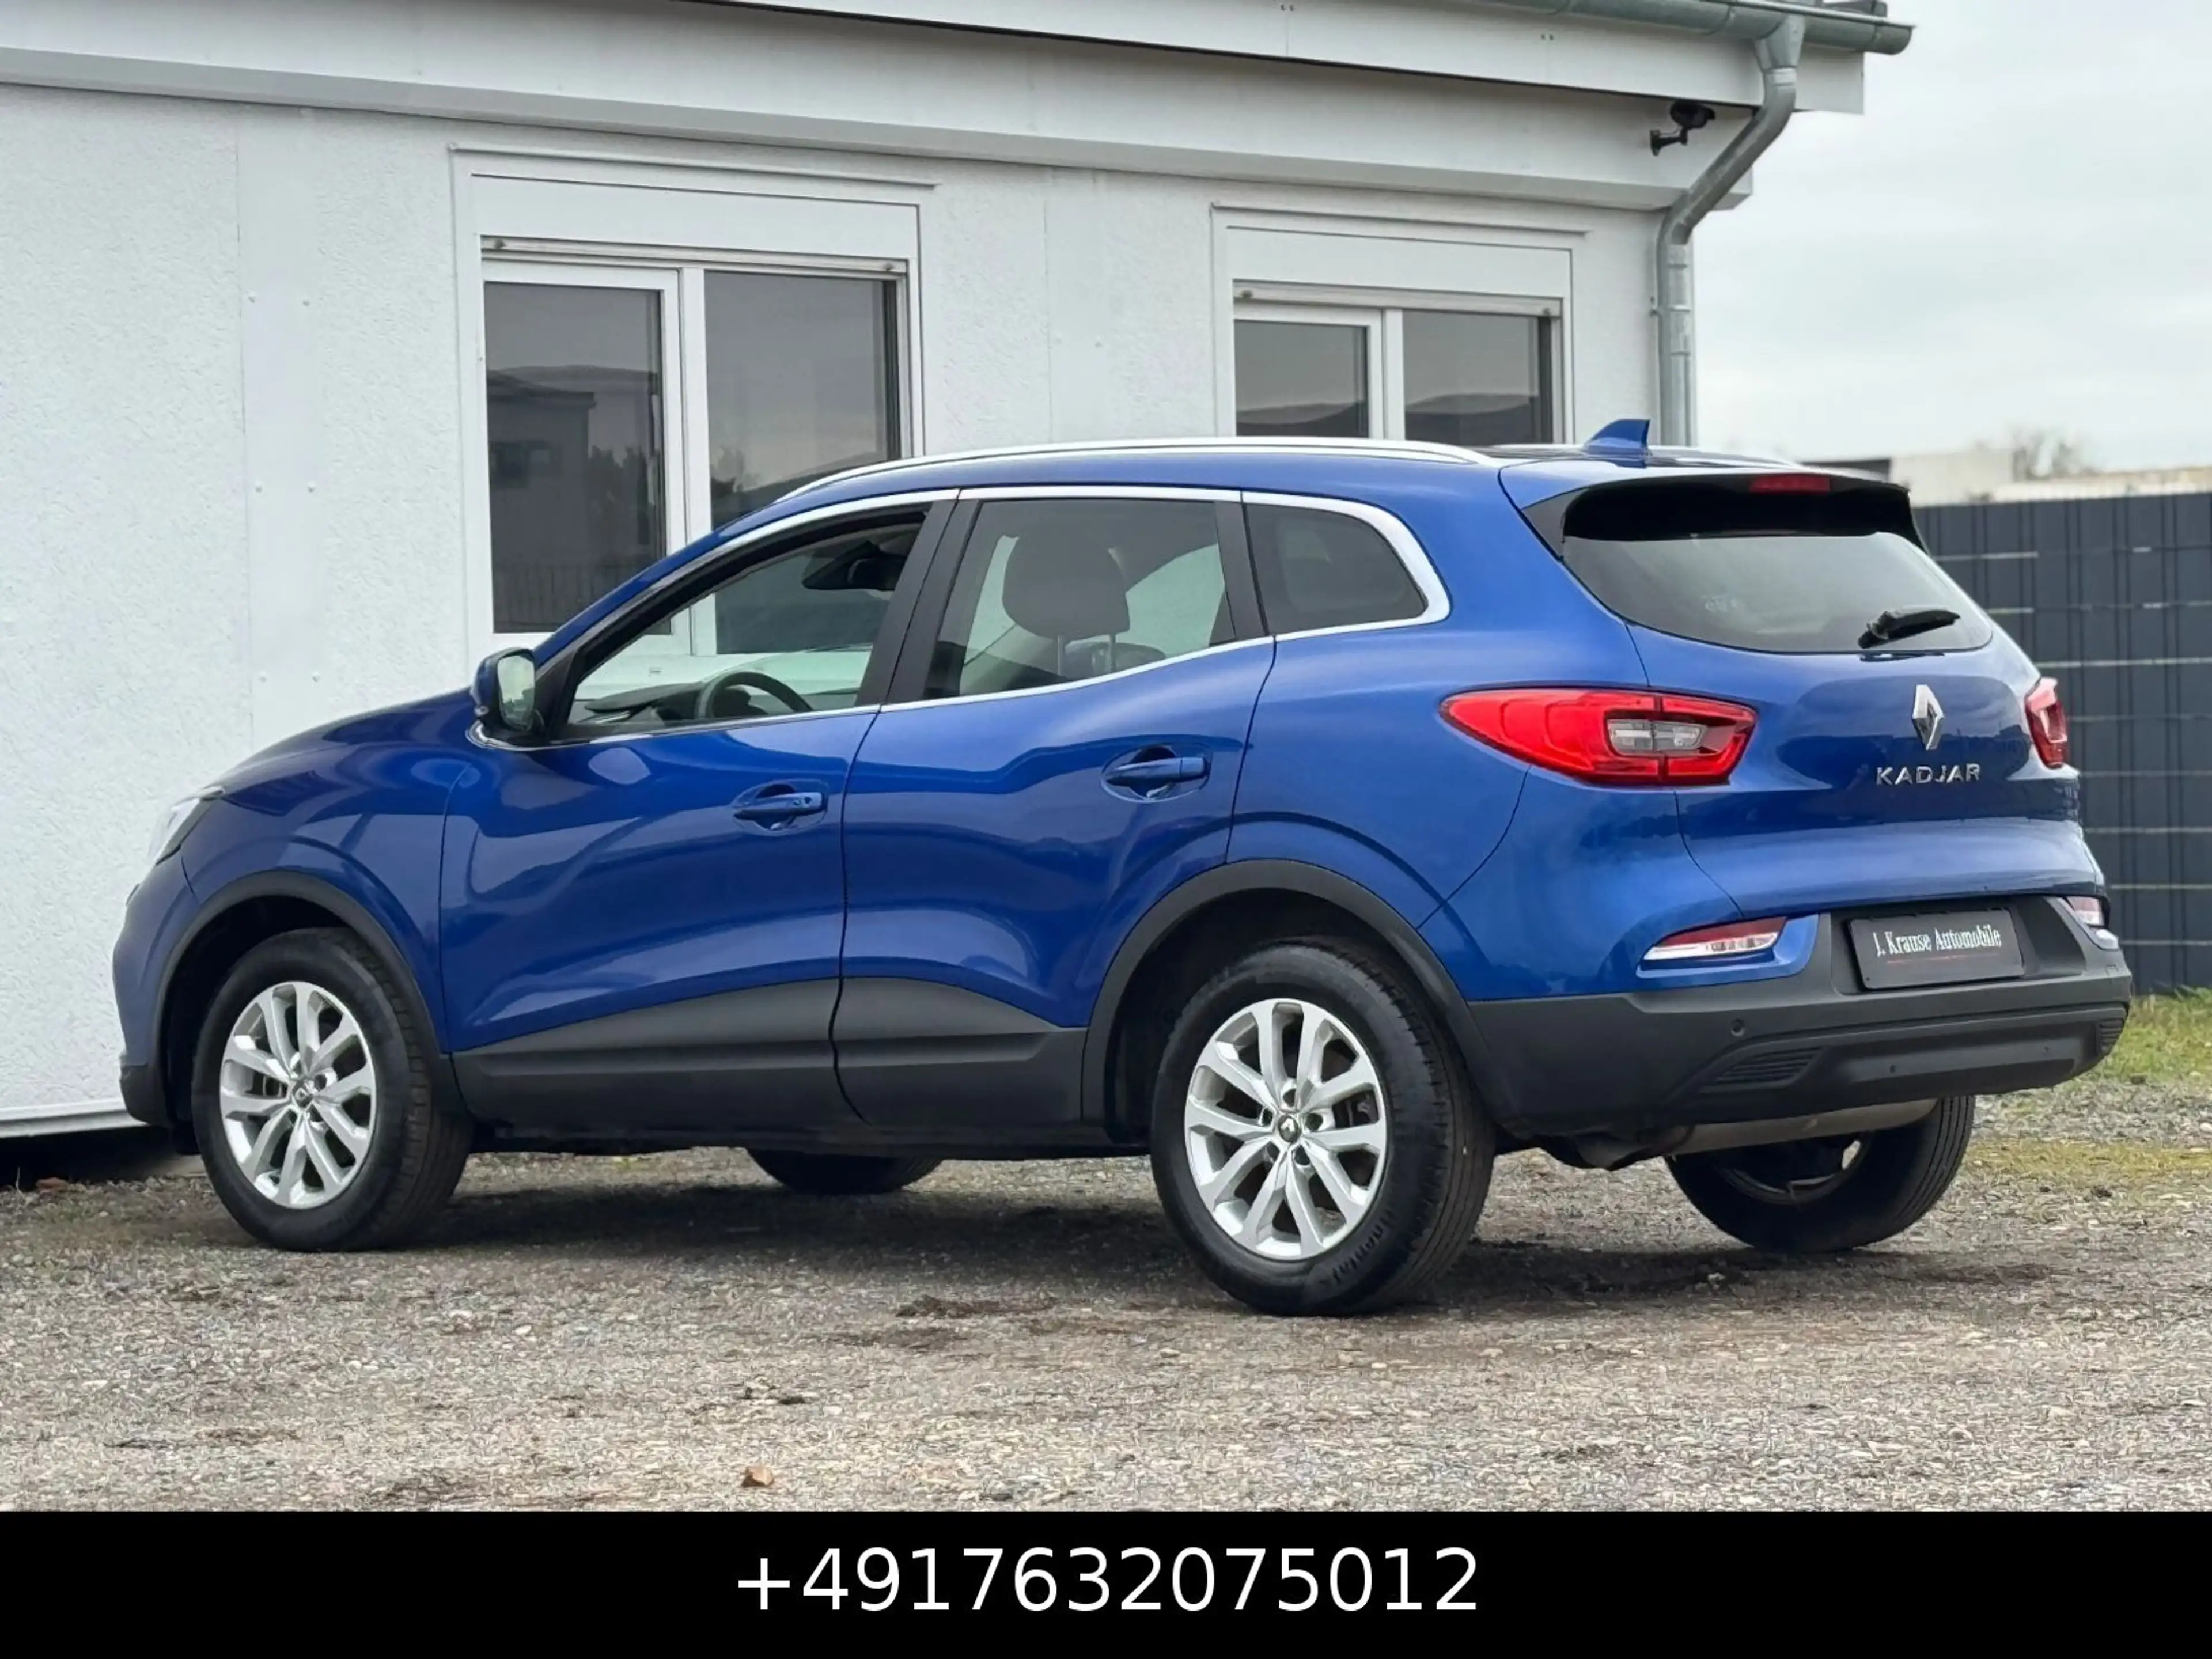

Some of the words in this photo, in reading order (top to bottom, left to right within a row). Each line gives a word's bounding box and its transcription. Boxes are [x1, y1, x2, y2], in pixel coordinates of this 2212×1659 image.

[1876, 763, 1980, 785] KADJAR
[1884, 931, 1932, 955] Krause
[1934, 923, 2002, 952] Automobile
